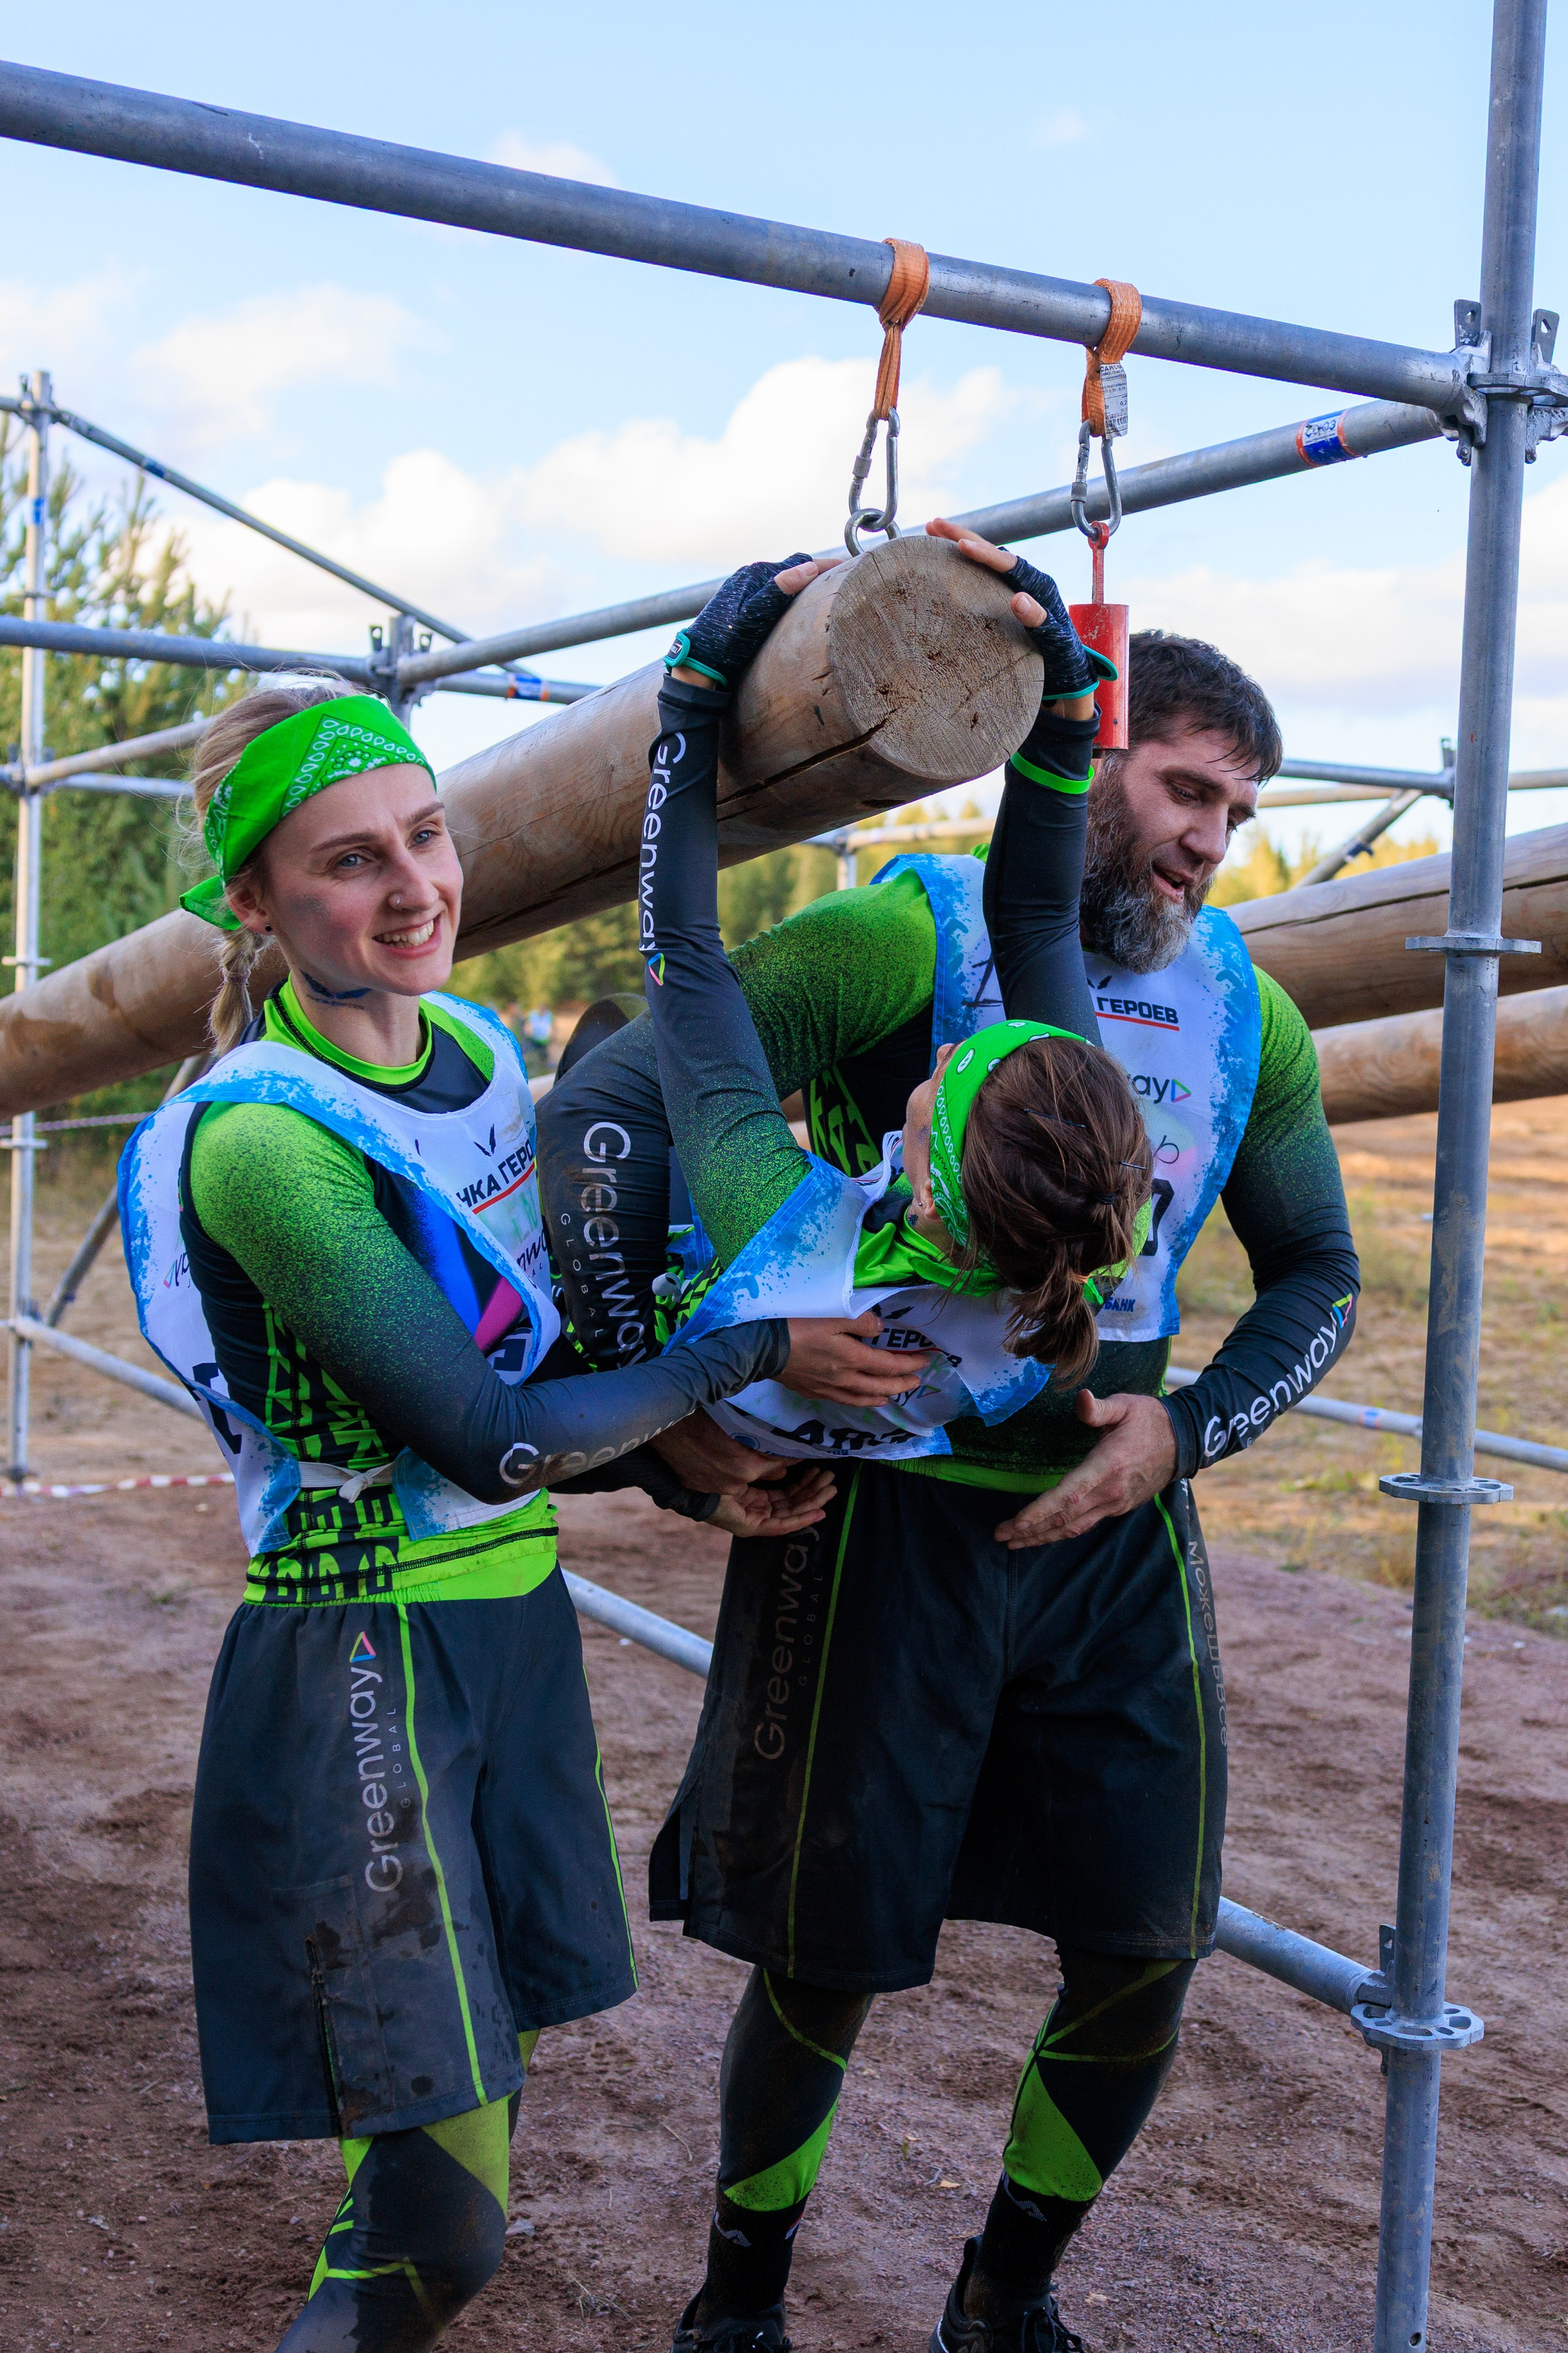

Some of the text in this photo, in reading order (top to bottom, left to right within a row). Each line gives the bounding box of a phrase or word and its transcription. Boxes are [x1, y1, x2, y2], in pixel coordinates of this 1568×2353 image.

[1096, 996, 1179, 1024] ГЕРОЕВ
[561, 1212, 604, 1338] GLOBAL
[1204, 1312, 1338, 1458] Greenway
[799, 1574, 824, 1686] GLOBAL
[349, 1667, 404, 1893] Greenway
[386, 1707, 412, 1809] GLOBAL
